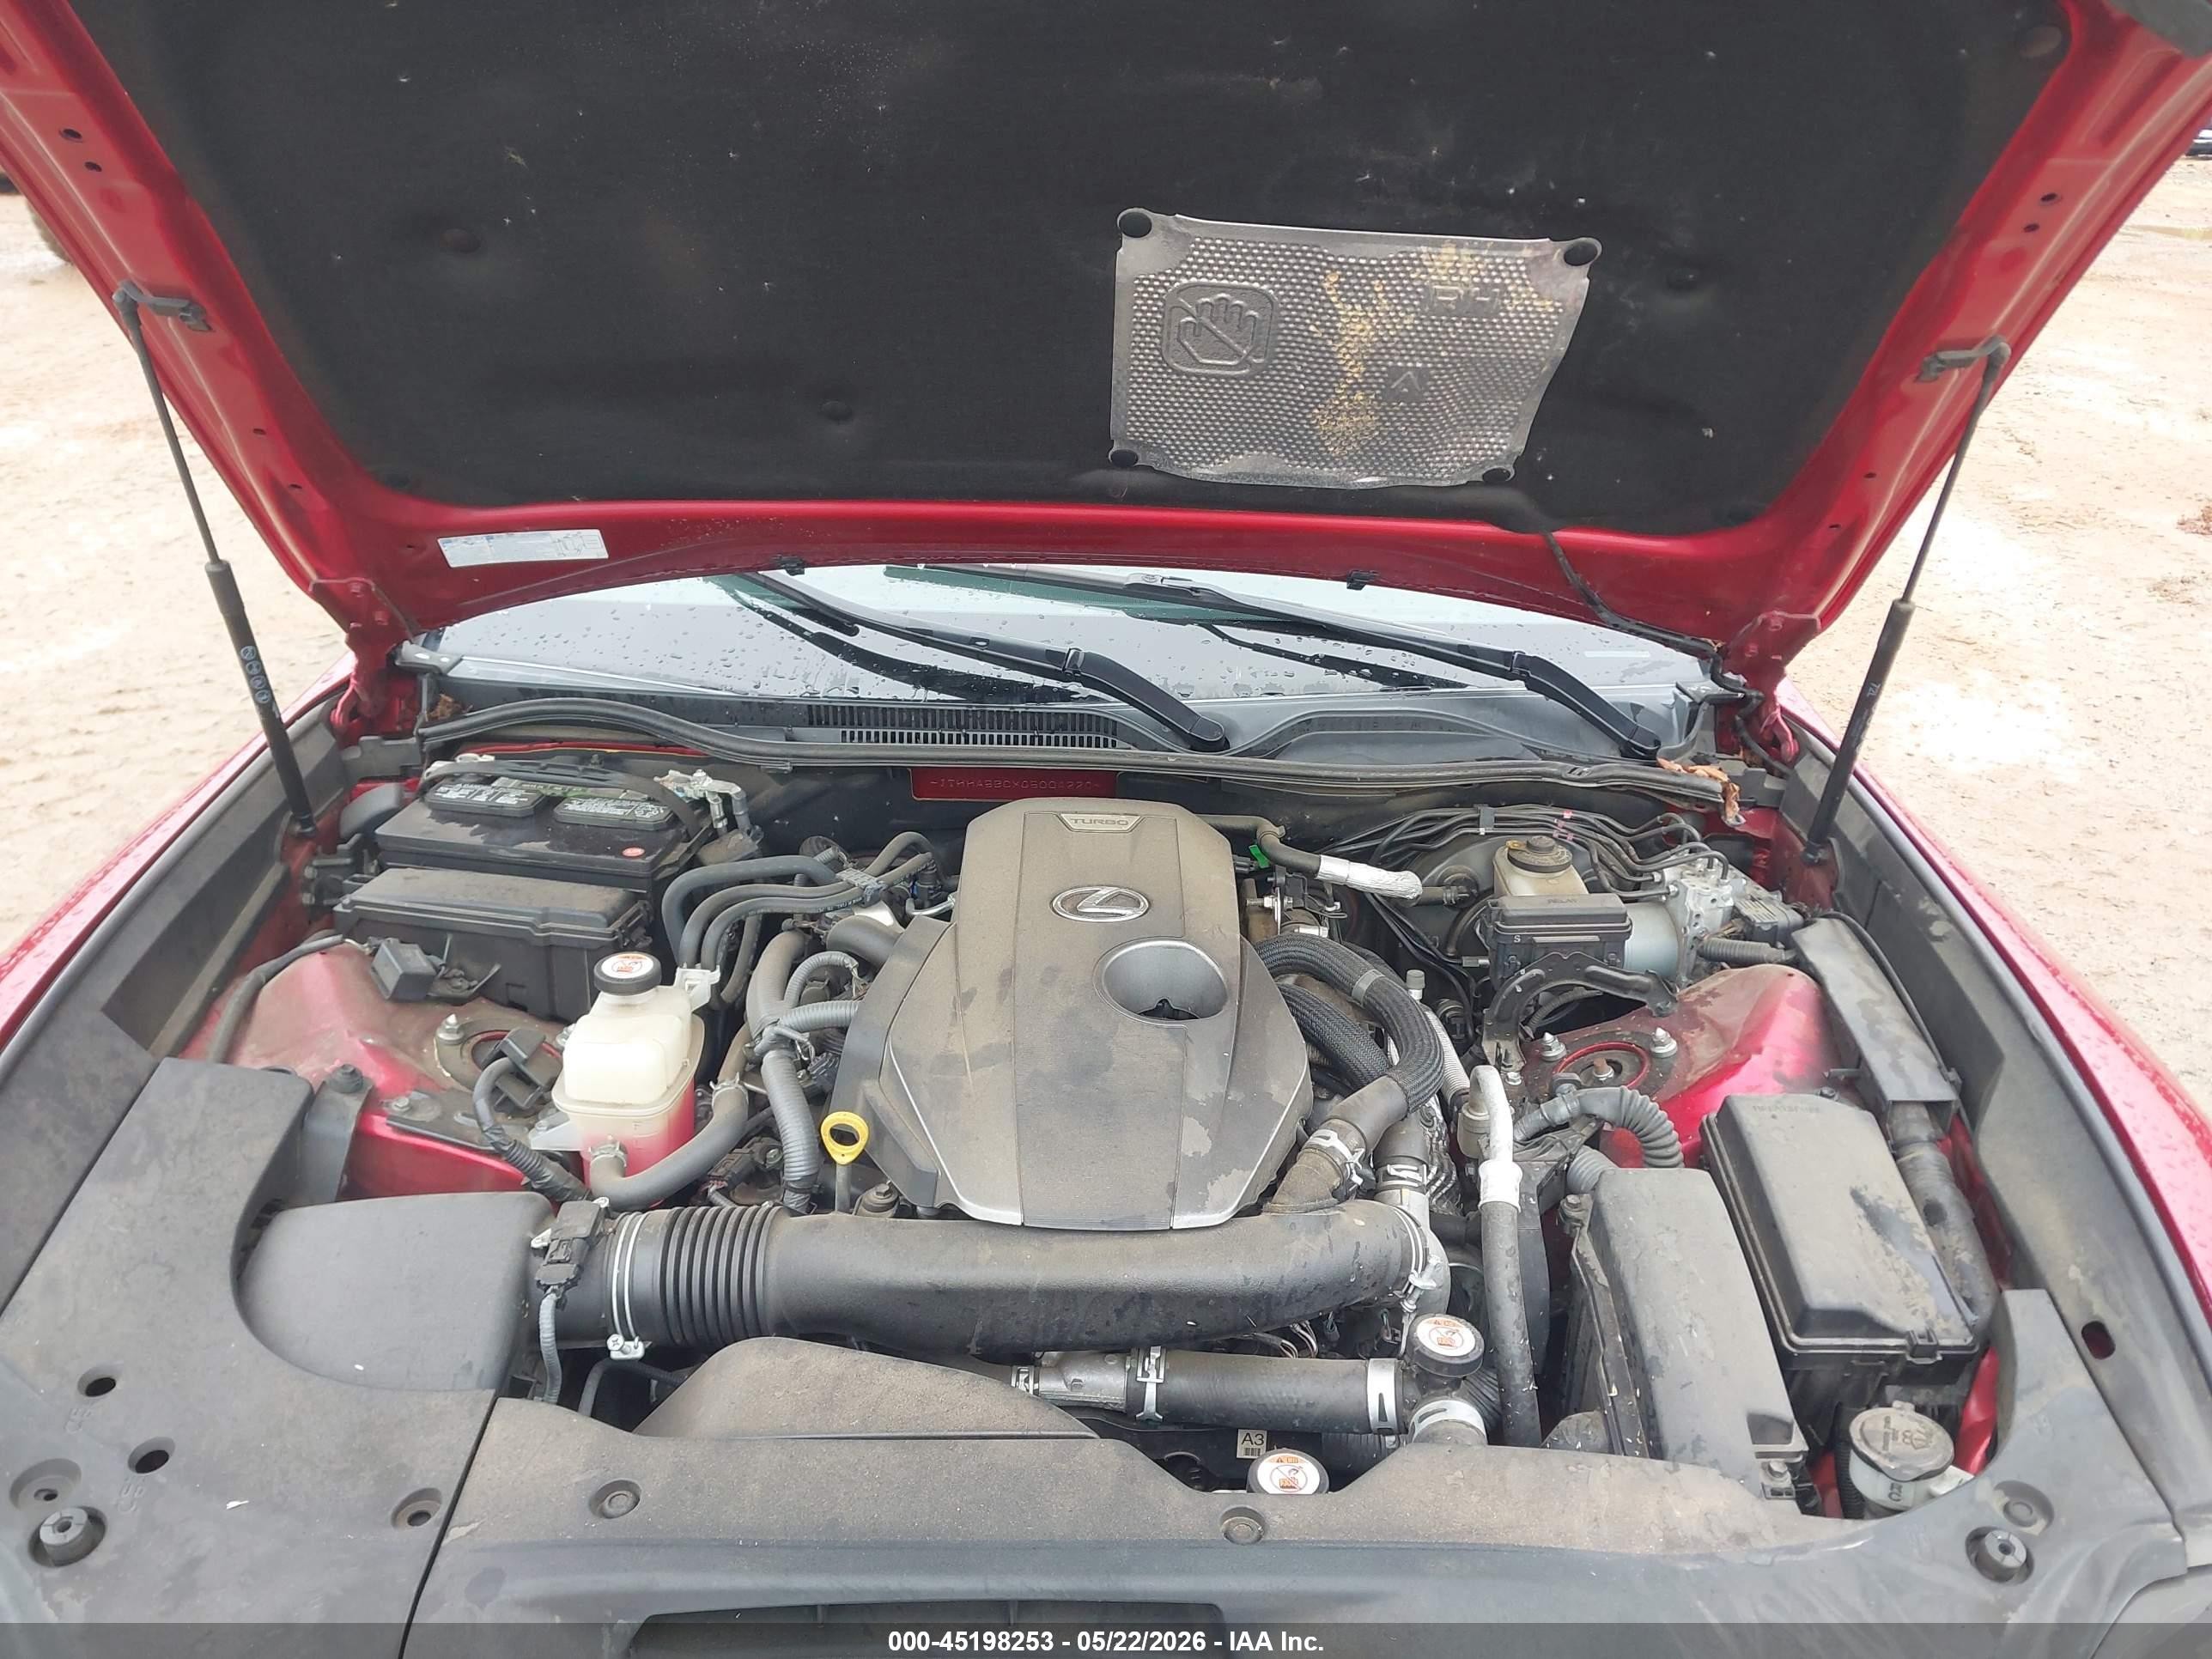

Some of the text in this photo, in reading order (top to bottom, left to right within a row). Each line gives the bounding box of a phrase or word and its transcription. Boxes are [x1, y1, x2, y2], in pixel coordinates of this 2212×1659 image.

[1070, 817, 1129, 826] TURBO
[1513, 934, 1522, 943] S
[1241, 1432, 1265, 1446] A3
